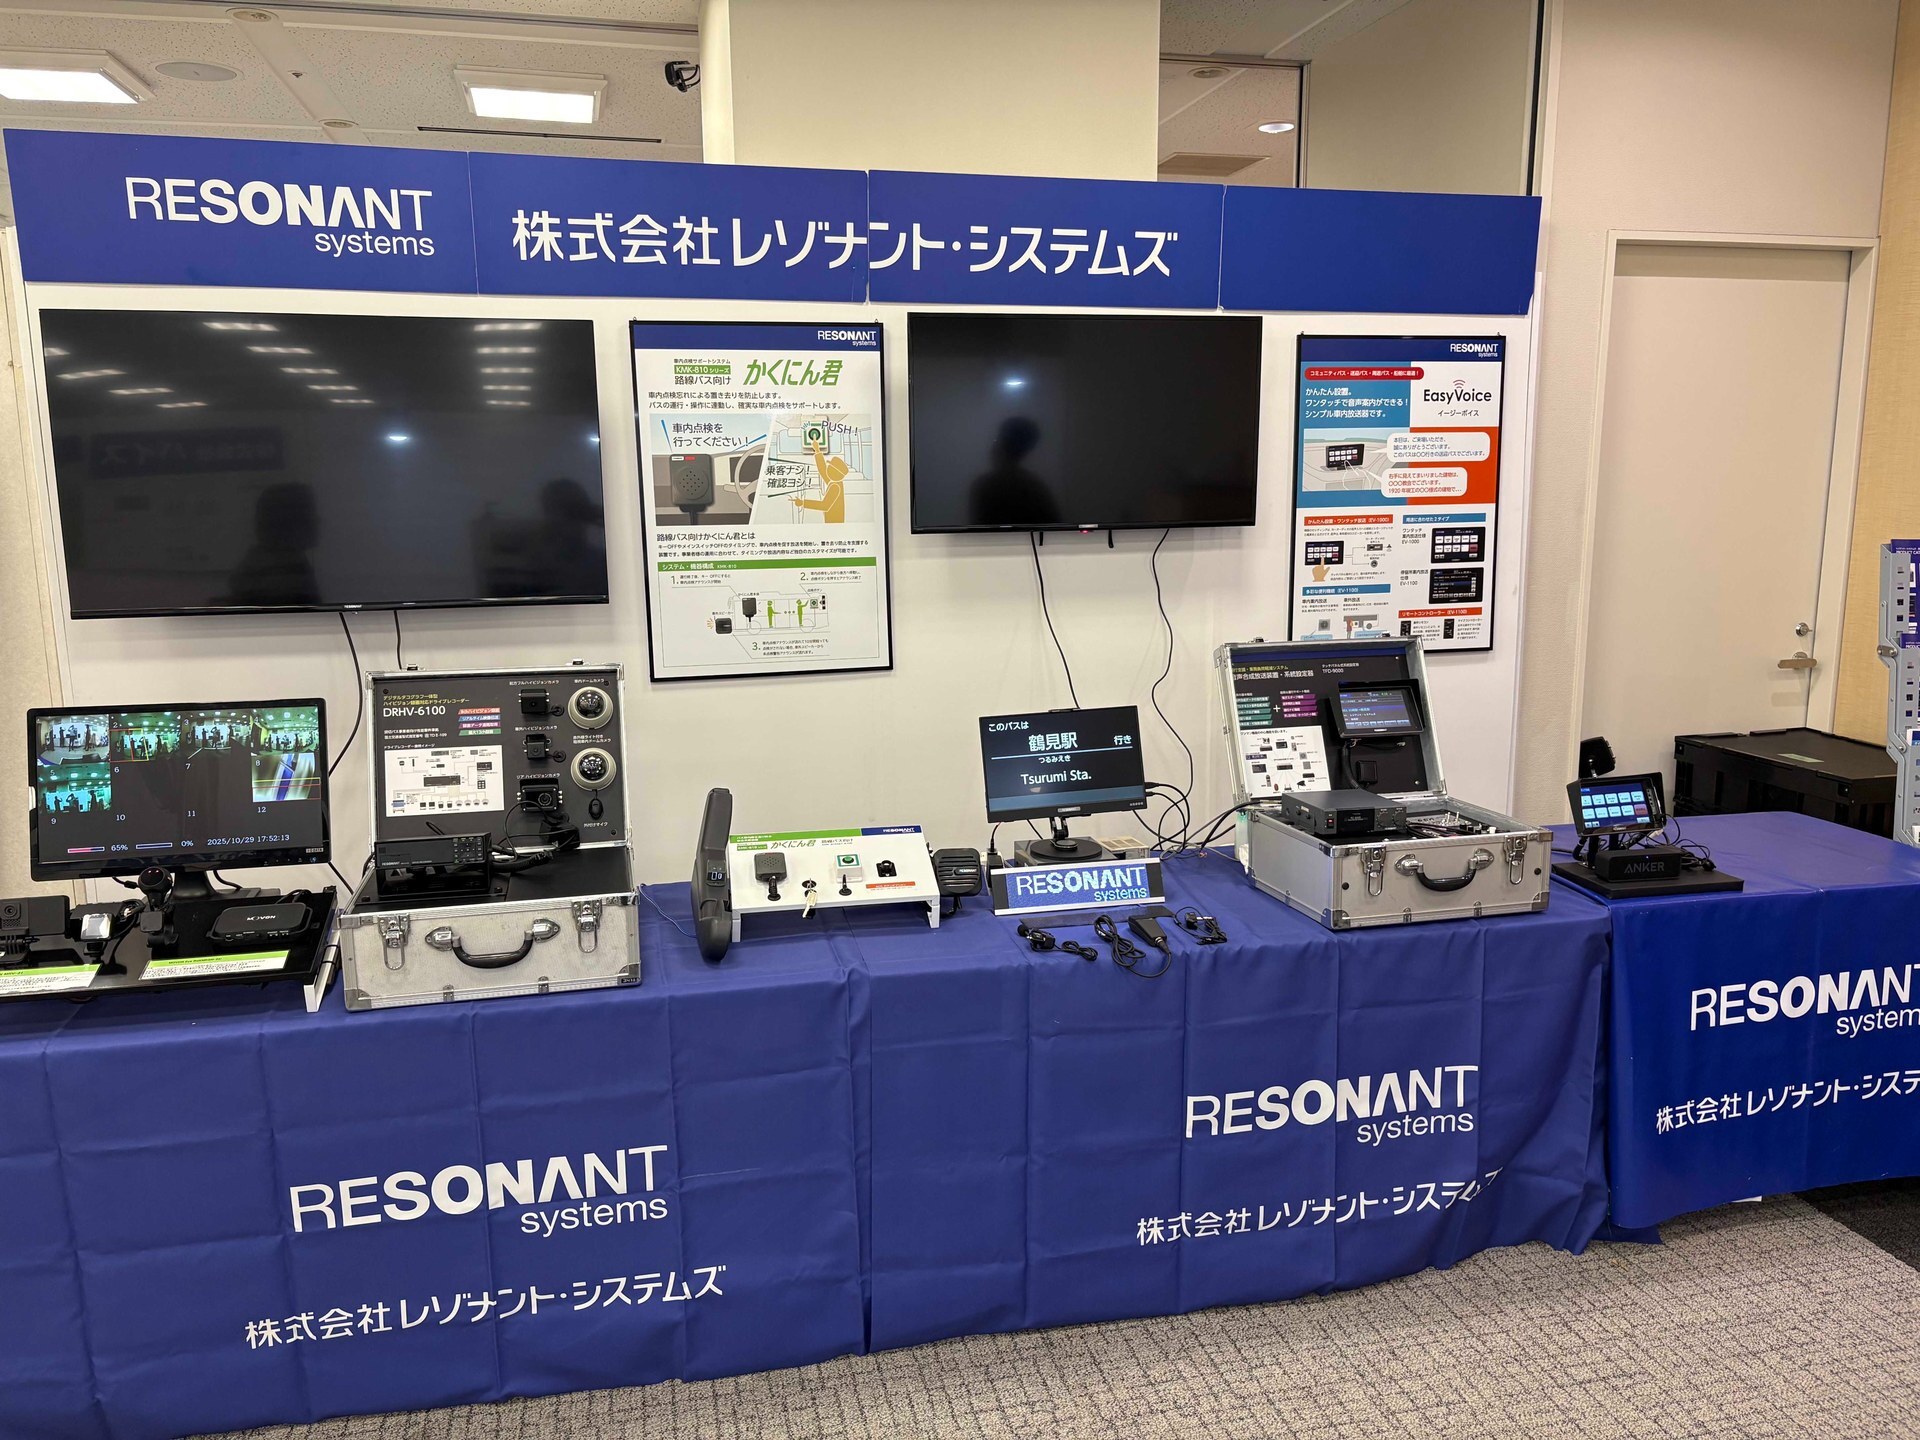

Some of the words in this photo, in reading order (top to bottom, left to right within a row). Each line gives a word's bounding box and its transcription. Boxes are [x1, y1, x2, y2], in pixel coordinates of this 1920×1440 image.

[124, 176, 433, 232] RESONANT
[314, 232, 435, 258] systems
[817, 330, 876, 342] RESONANT
[1450, 343, 1499, 353] RESONANT
[743, 359, 843, 386] かくにん君
[674, 375, 731, 386] 路線バス向け
[648, 391, 783, 400] 車内点検忘れによる置き去りを防止します。
[1306, 388, 1351, 396] かんたん設置。
[1423, 388, 1492, 404] EasyVoice
[672, 423, 723, 433] 車内点検を
[673, 436, 749, 447] 行ってください！
[765, 465, 811, 476] 乗客ナシ！
[766, 478, 812, 488] 確認ヨシ！
[656, 532, 756, 542] 路線バス向けかくにん君とは
[800, 572, 808, 581] 2.
[752, 642, 761, 651] 3.
[383, 705, 446, 717] DRHV-6100
[988, 721, 1029, 732] このバスは
[1028, 732, 1078, 752] 鶴見駅
[1113, 735, 1132, 745] 行き
[1038, 755, 1071, 763] つるみえき
[1021, 771, 1067, 785] Tsurumi
[1070, 769, 1092, 781] Sta.
[207, 836, 255, 846] 2025/10/29
[257, 834, 290, 843] 17:52:13
[111, 844, 128, 852] 65%
[1624, 861, 1665, 873] ANKER
[1016, 866, 1146, 896] RESONANT
[1094, 887, 1147, 902] systems
[1185, 1065, 1478, 1138] RESONANT
[1356, 1112, 1474, 1146] systems
[289, 1144, 667, 1232] RESONANT
[520, 1198, 668, 1237] systems
